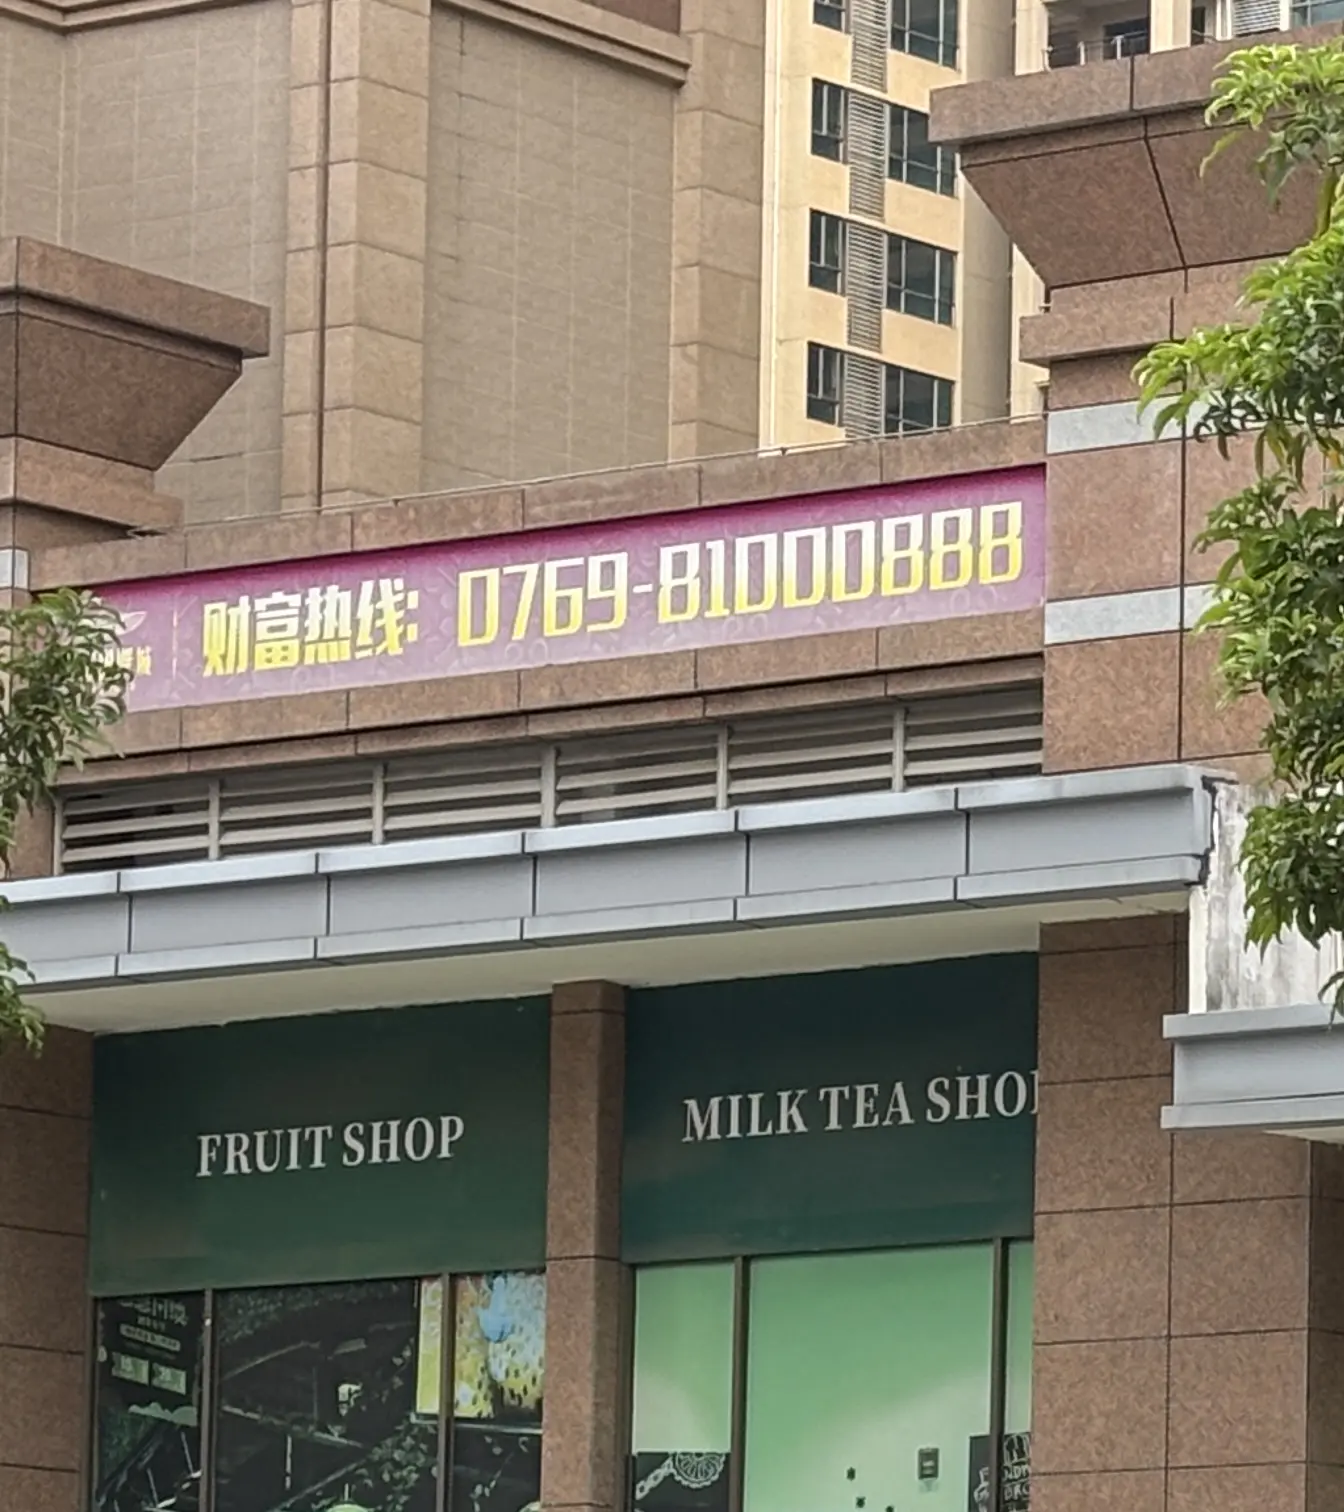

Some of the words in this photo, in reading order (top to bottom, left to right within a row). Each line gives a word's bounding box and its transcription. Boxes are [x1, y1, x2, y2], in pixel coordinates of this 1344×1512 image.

[456, 500, 1024, 648] 0769-81000888
[202, 578, 419, 677] 财富热线:
[196, 1124, 333, 1177] FRUIT
[342, 1115, 465, 1167] SHOP
[682, 1088, 808, 1142] MILK
[819, 1081, 914, 1131] TEA
